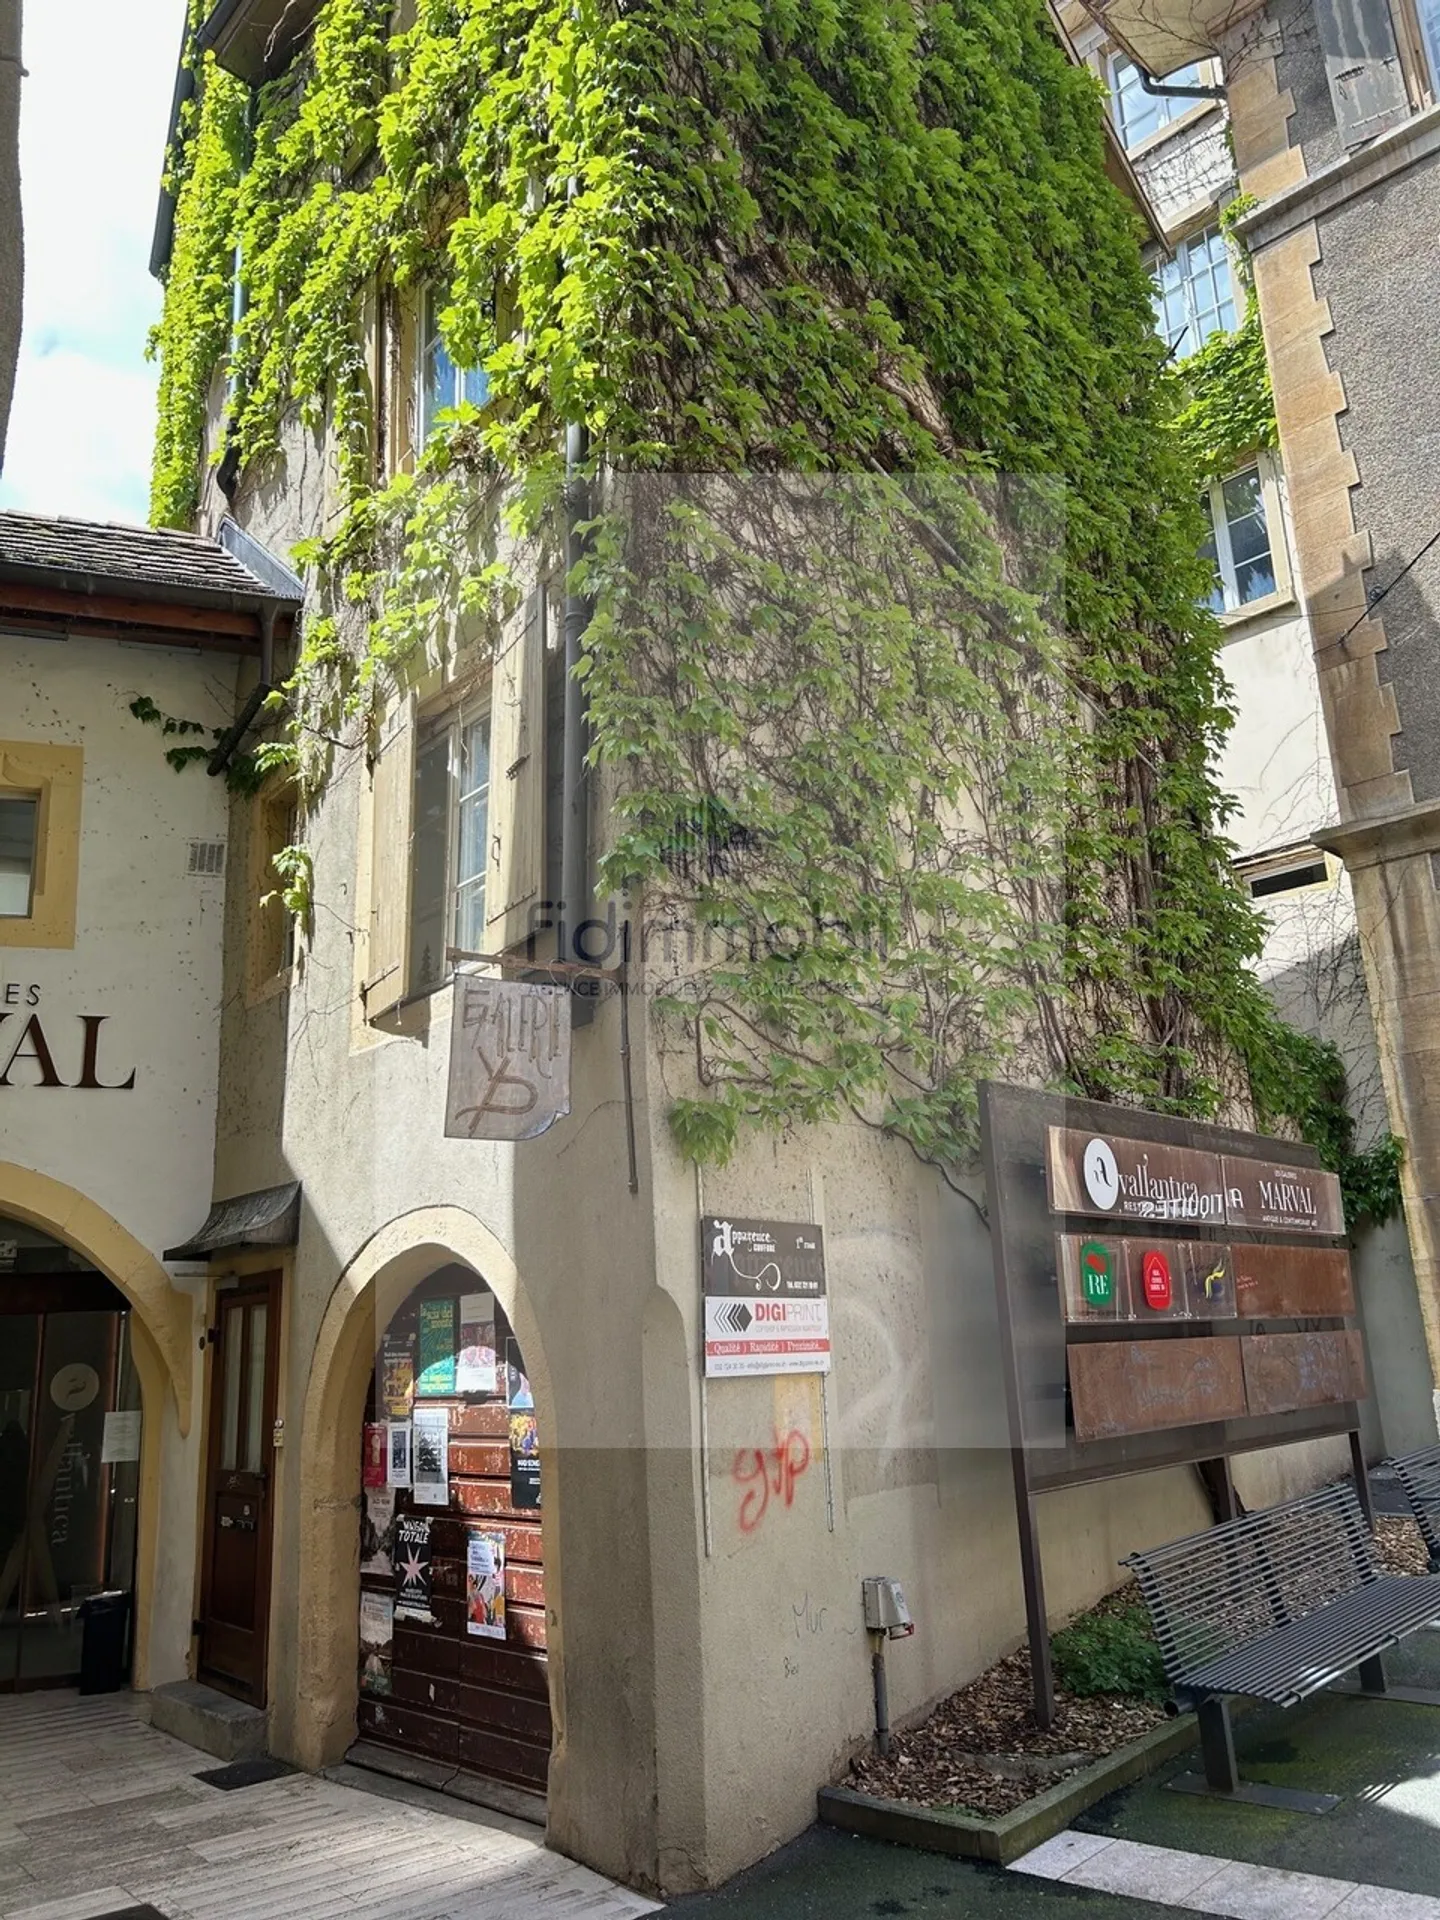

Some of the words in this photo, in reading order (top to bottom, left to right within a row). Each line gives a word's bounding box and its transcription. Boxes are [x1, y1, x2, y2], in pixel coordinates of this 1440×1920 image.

[1259, 1180, 1317, 1215] MARVAL
[755, 1303, 822, 1322] DIGIPRINT
[399, 1529, 429, 1544] TOTALE
